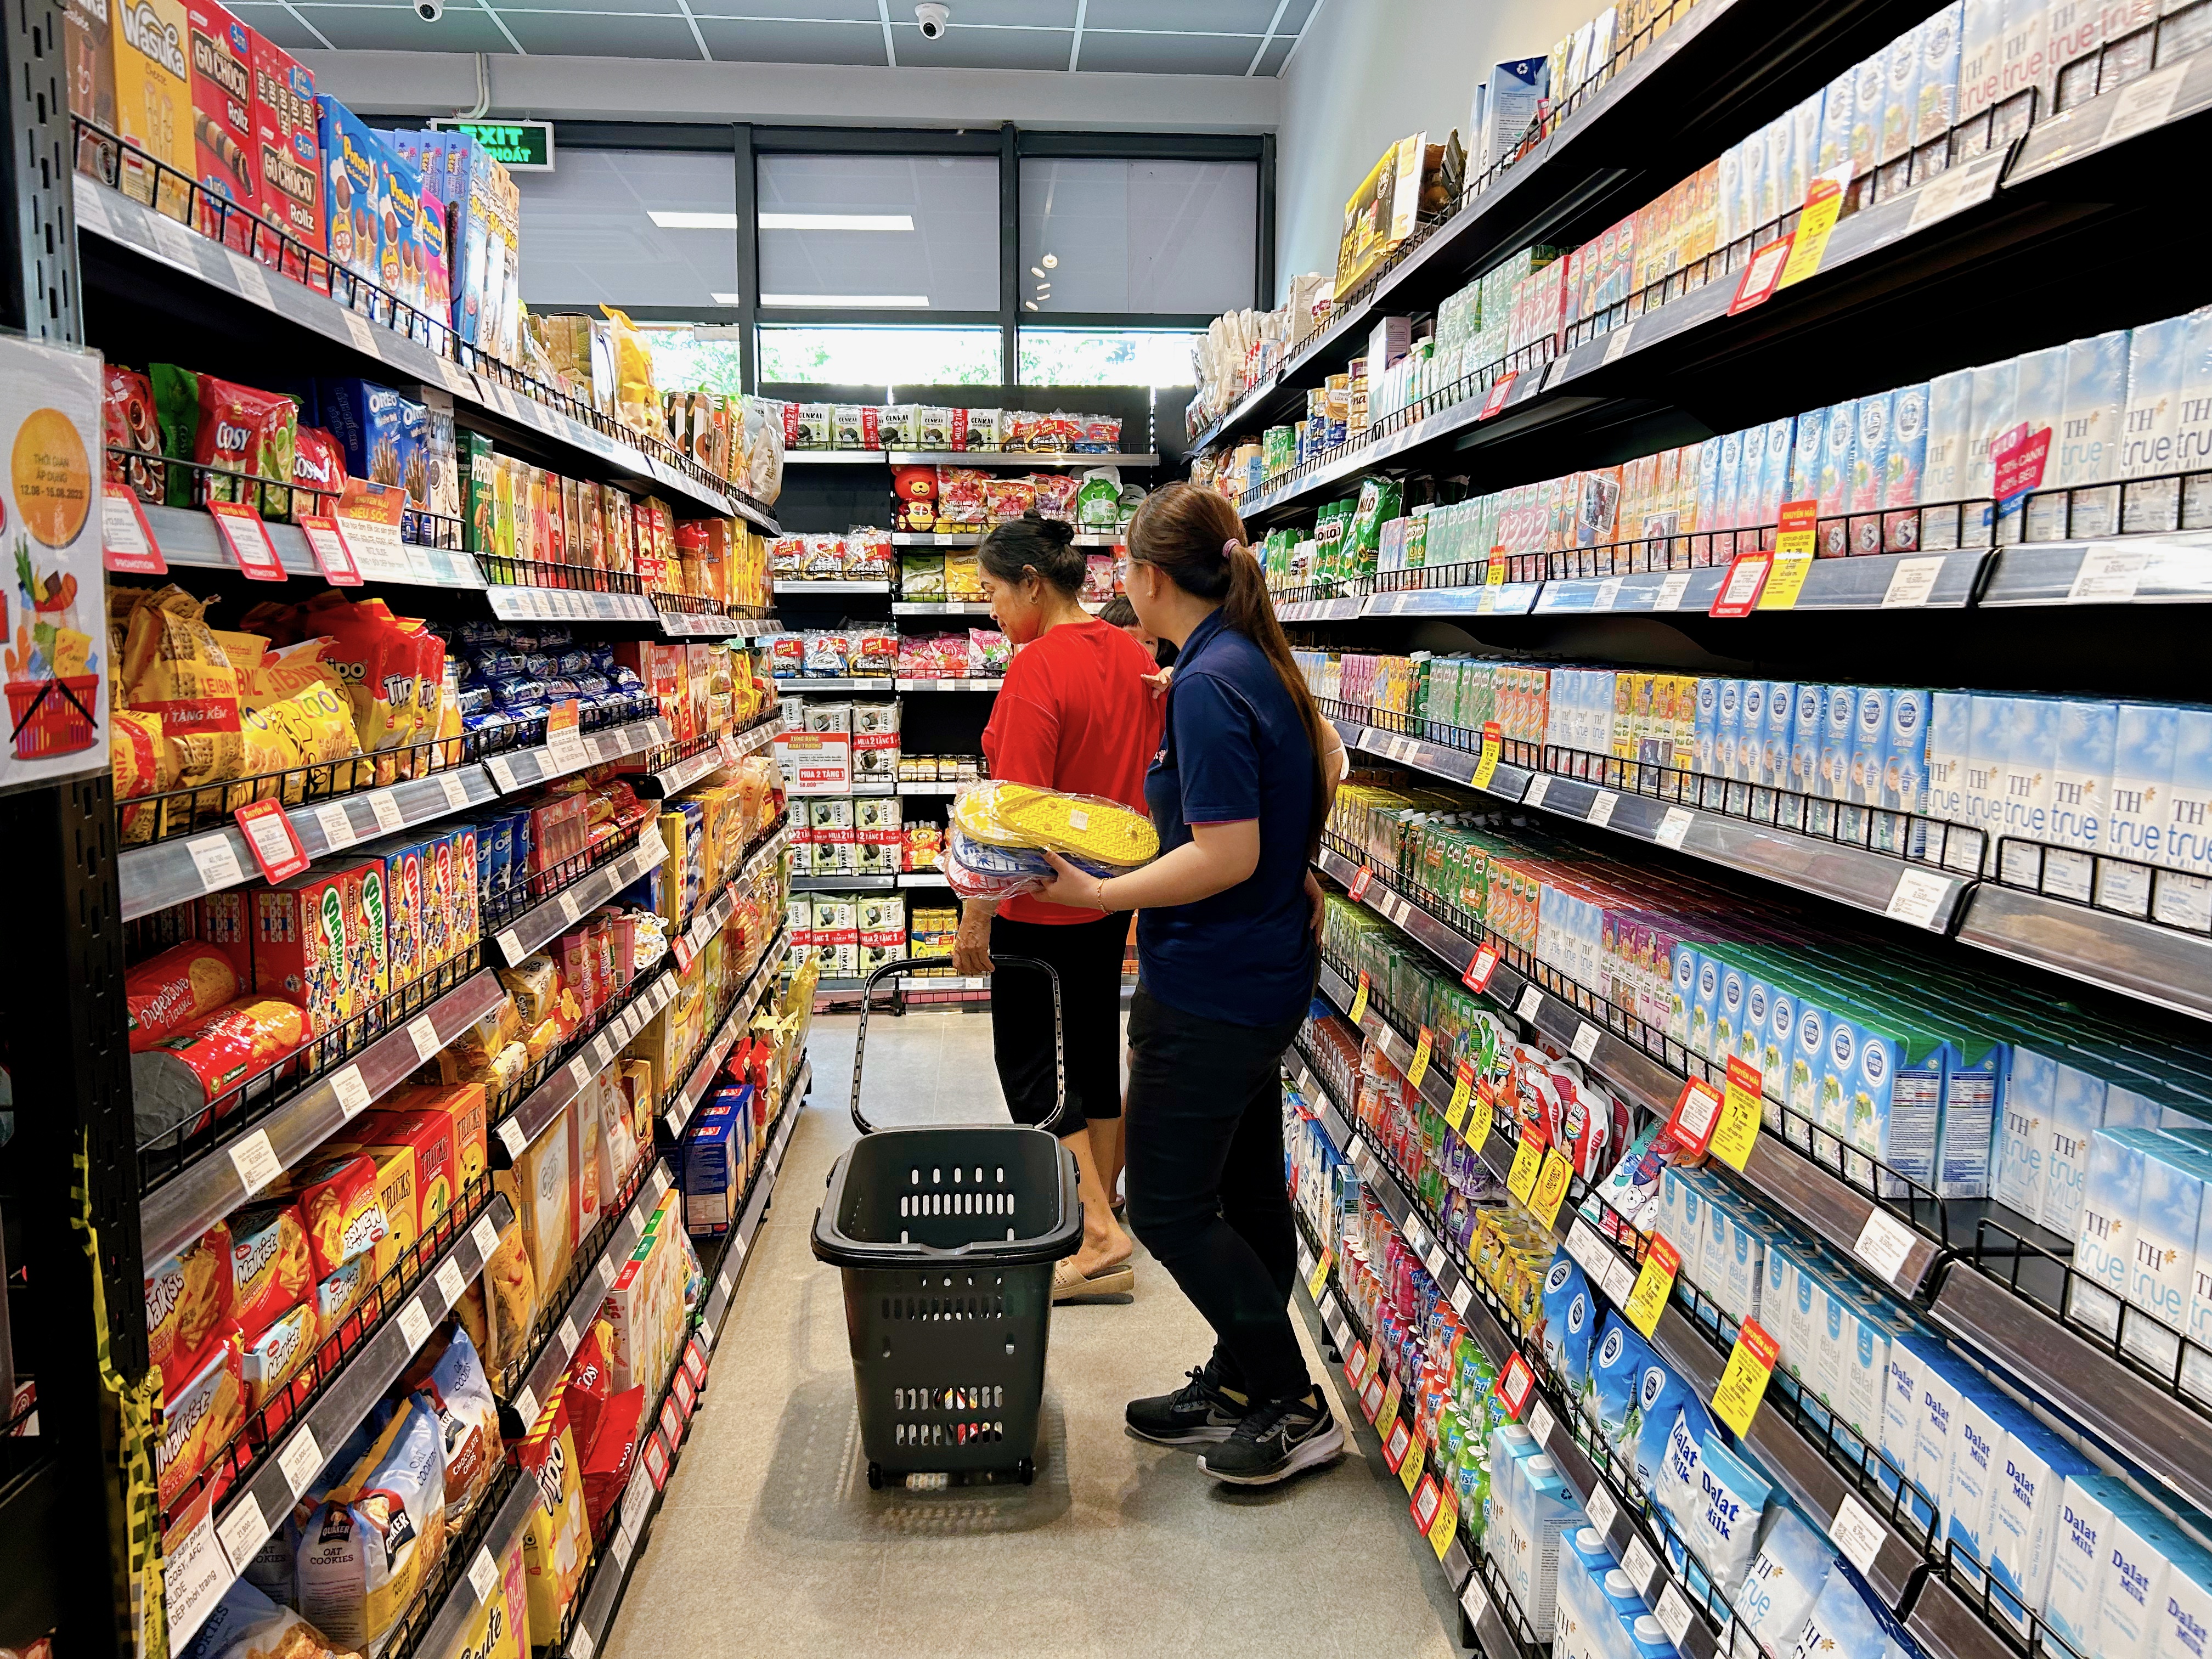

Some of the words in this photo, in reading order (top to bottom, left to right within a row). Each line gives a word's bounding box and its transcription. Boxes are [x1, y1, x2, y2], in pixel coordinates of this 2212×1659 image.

[2049, 22, 2095, 65] true
[214, 52, 246, 100] CHOCO
[2002, 52, 2043, 92] true
[227, 100, 249, 132] Rollz
[459, 125, 523, 146] EXIT
[278, 162, 313, 201] CHOCO
[290, 204, 314, 229] Rollz
[369, 390, 397, 414] OREO
[2126, 408, 2155, 433] TH
[216, 421, 251, 452] COSY
[2122, 436, 2171, 467] true
[471, 453, 493, 483] PEPERO
[2061, 439, 2103, 466] true
[1359, 496, 1376, 517] MILO
[226, 645, 252, 657] Original
[857, 737, 871, 746] MUA
[890, 736, 894, 744] 1
[1930, 762, 1948, 782] TH
[1968, 769, 1989, 789] TH
[2008, 775, 2032, 797] TH
[1928, 786, 1960, 811] true
[1966, 791, 2002, 821] true
[2055, 781, 2083, 805] TH
[2113, 789, 2142, 814] TH
[2004, 796, 2045, 830] true
[2051, 803, 2098, 840] true
[2173, 799, 2207, 826] TH
[841, 830, 847, 839] 2
[879, 832, 884, 840] 1
[2109, 812, 2160, 849] true
[861, 935, 874, 944] MUA
[873, 934, 880, 943] 2
[893, 933, 898, 942] 1
[140, 978, 190, 1030] Digestive
[165, 995, 193, 1029] Classic
[1730, 1064, 1750, 1081] KHUYẾN
[1749, 1072, 1759, 1086] MÃI
[457, 1104, 482, 1148] TRICKS
[2009, 1112, 2028, 1137] TH
[421, 1133, 449, 1184] TRICKS
[2005, 1133, 2042, 1170] true
[2053, 1132, 2076, 1159] TH
[2004, 1155, 2039, 1192] MILK
[2049, 1151, 2085, 1192] true
[381, 1169, 411, 1212] TRICKS
[2085, 1209, 2111, 1241] TH
[237, 1233, 278, 1289] Malkist
[2080, 1231, 2125, 1282] true
[2137, 1238, 2164, 1272] TH
[330, 1268, 359, 1316] Malkist
[2132, 1261, 2181, 1315] true
[1743, 1323, 1764, 1350] KHUYẾN
[1763, 1343, 1774, 1358] MÃI
[267, 1327, 301, 1386] Malkist
[1892, 1361, 1914, 1391] Dalat
[1896, 1380, 1911, 1403] Milk
[1925, 1391, 1950, 1424] Dalat
[155, 1391, 210, 1474] Malkist
[1930, 1412, 1947, 1436] Milk
[453, 1434, 479, 1476] CHOCOLATE
[1673, 1417, 1697, 1469] Dalat
[1964, 1423, 1991, 1458] Dalat
[462, 1452, 478, 1475] CHIPS
[1671, 1444, 1691, 1484] Milk
[1970, 1446, 1988, 1471] Milk
[2005, 1459, 2035, 1497] Dalat
[1701, 1471, 1741, 1522] Dalat
[2012, 1483, 2032, 1510] Milk
[323, 1525, 349, 1536] QUAKER
[1705, 1504, 1731, 1542] Milk
[2063, 1505, 2097, 1545] Dalat
[310, 1554, 354, 1565] COOKIES
[323, 1547, 342, 1557] OAT
[2071, 1530, 2094, 1559] Milk
[392, 1561, 414, 1590] HONEY
[2112, 1549, 2150, 1592] Dalat
[2120, 1576, 2146, 1607] Milk
[2168, 1596, 2208, 1644] Dalat
[2175, 1624, 2204, 1658] Milk
